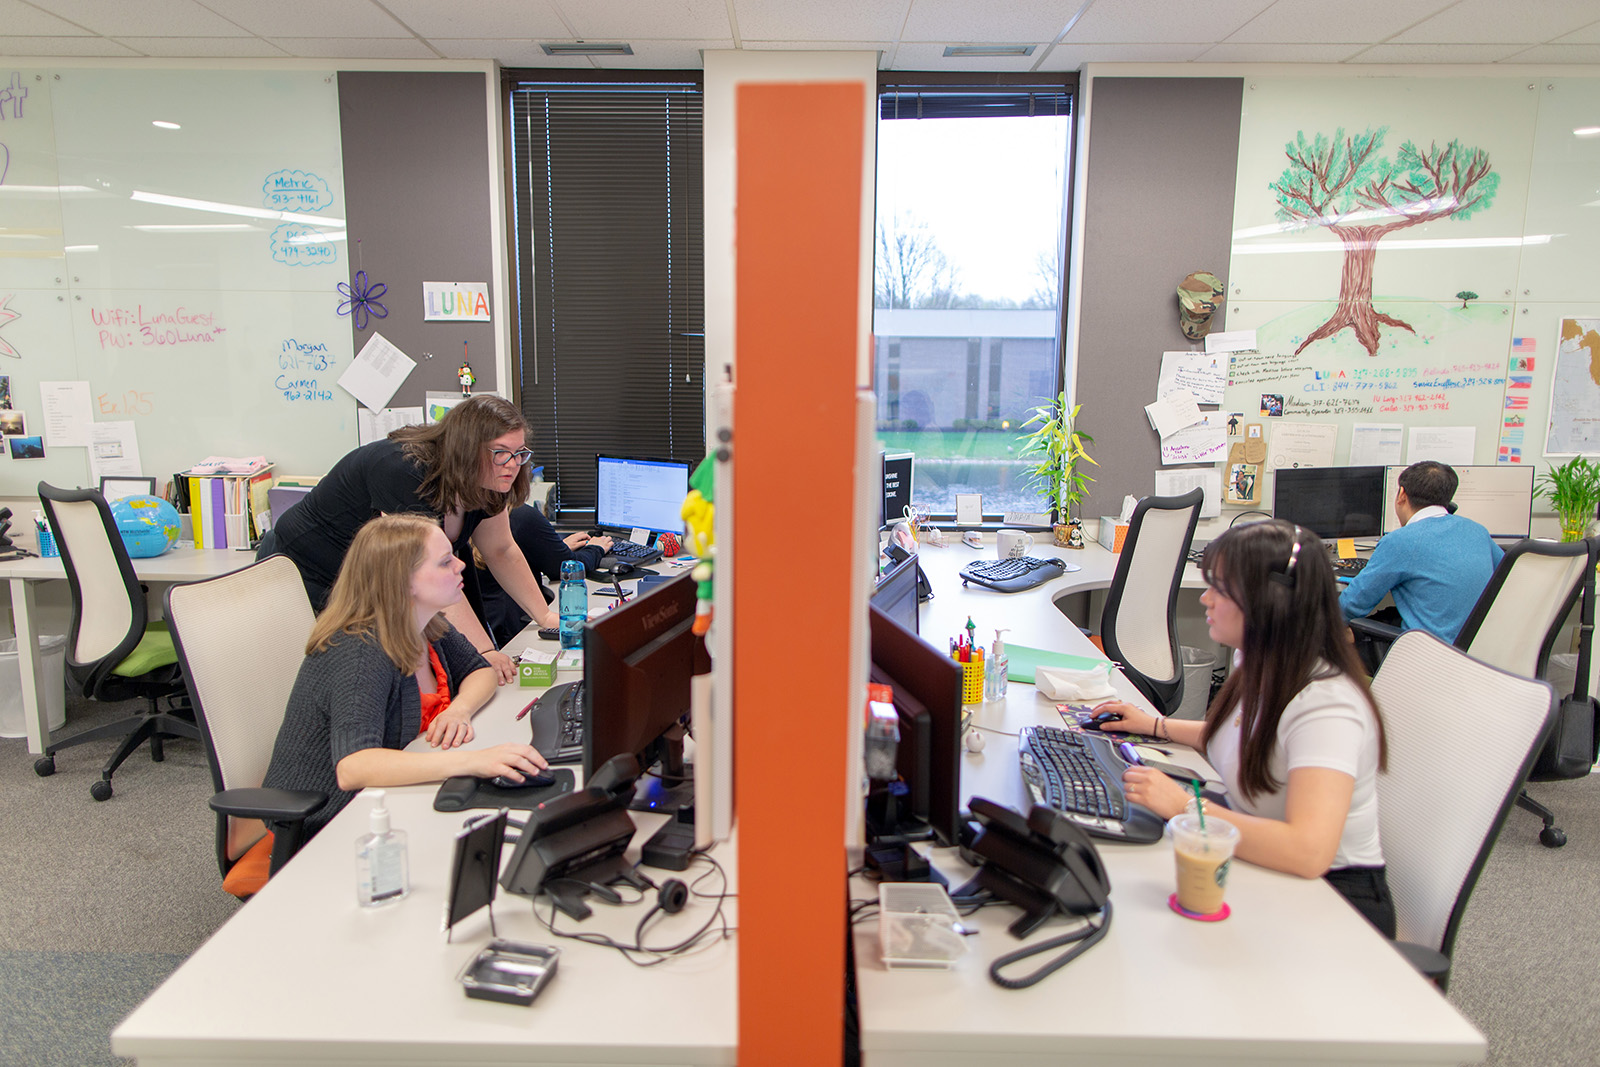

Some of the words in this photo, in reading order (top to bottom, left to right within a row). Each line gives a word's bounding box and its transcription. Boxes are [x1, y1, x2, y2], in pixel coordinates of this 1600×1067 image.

[275, 177, 314, 189] Metric
[272, 194, 319, 204] 513-4161
[428, 291, 490, 316] LUNA
[99, 330, 133, 350] PW:
[282, 338, 328, 354] Morgan
[275, 374, 317, 390] Carmen
